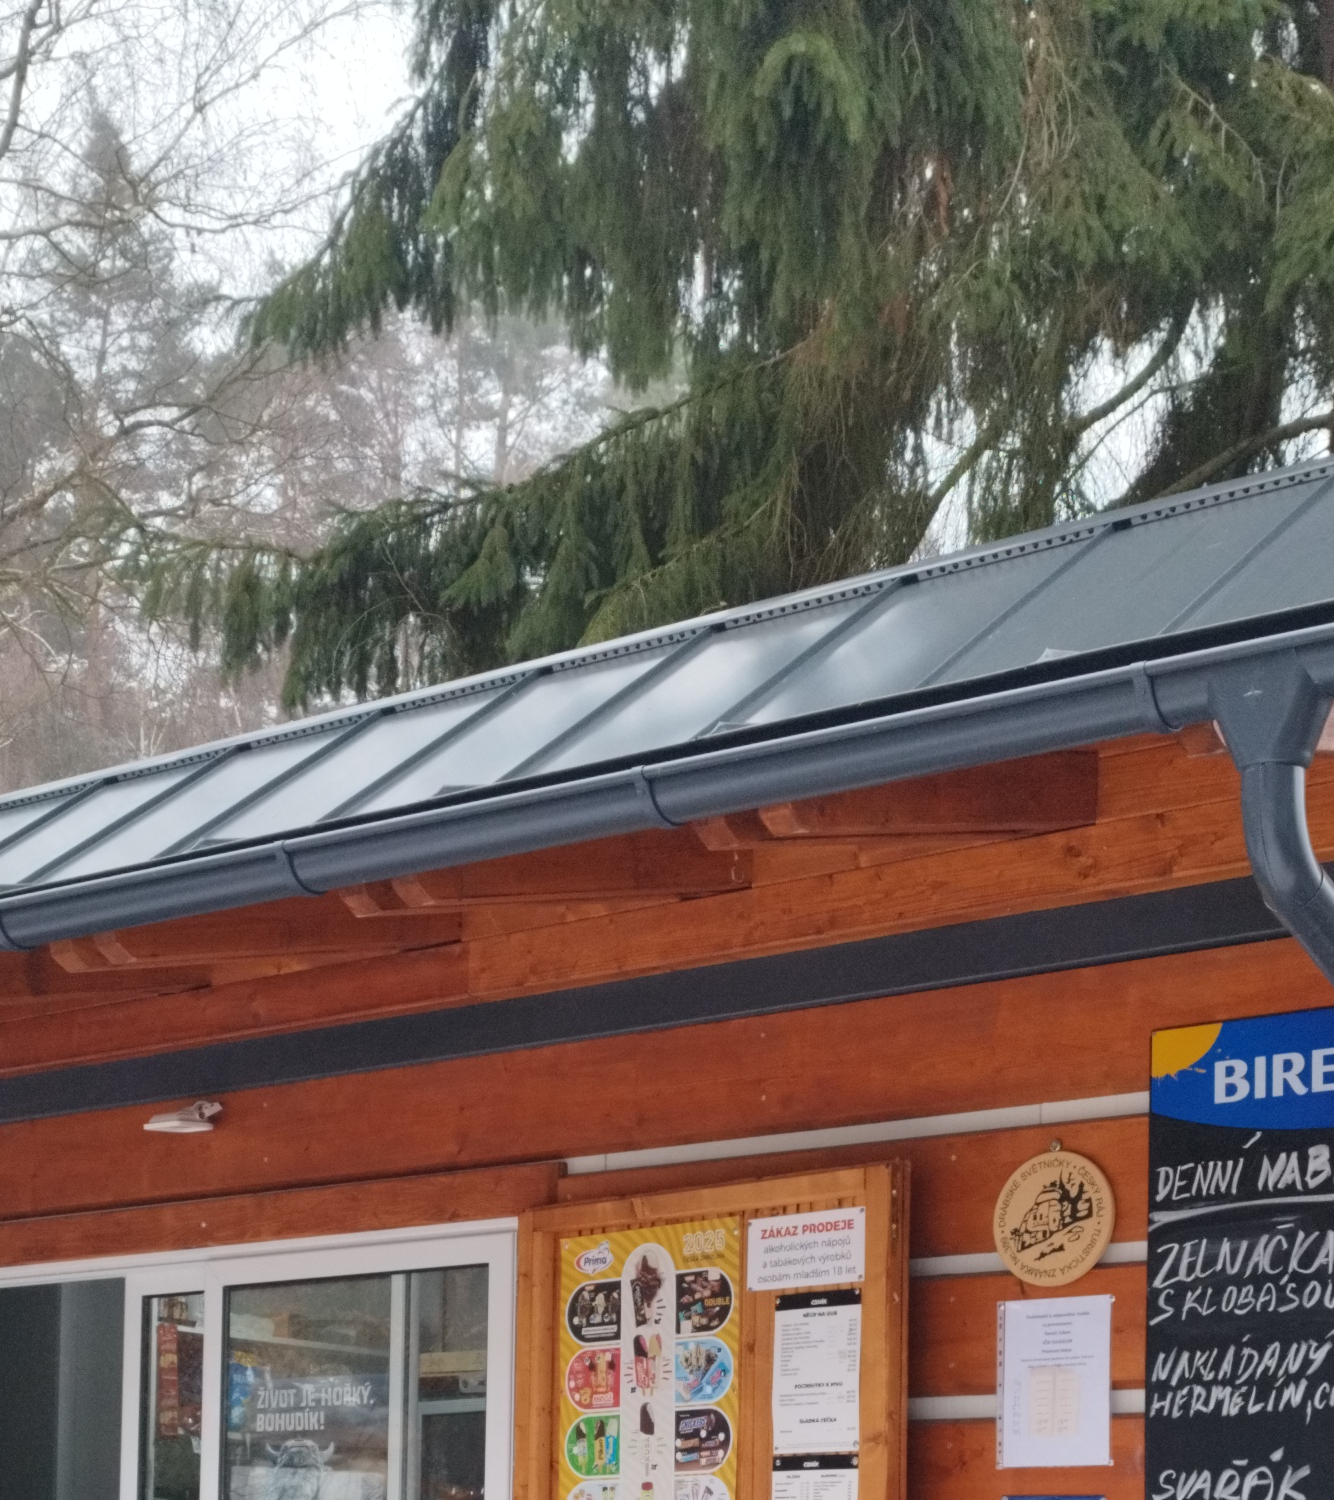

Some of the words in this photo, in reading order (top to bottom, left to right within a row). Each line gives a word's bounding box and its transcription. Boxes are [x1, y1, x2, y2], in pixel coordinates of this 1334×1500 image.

[1155, 1131, 1263, 1203] DENNÍ
[760, 1224, 799, 1240] ZÁKAZ
[801, 1218, 855, 1235] PRODEJE
[682, 1228, 726, 1256] 2025
[763, 1238, 819, 1255] alkoholických
[821, 1235, 851, 1249] nápojů
[583, 1255, 608, 1267] Prima
[769, 1253, 816, 1268] tabákových
[818, 1250, 852, 1265] výrobků
[757, 1271, 791, 1284] osobám
[793, 1267, 830, 1280] mladším
[845, 1265, 857, 1274] let
[256, 1386, 297, 1409] ŽIVOT
[300, 1386, 317, 1408] JE
[320, 1381, 375, 1407] HOŘKÝ.
[255, 1408, 326, 1433] BOHUDÍK!
